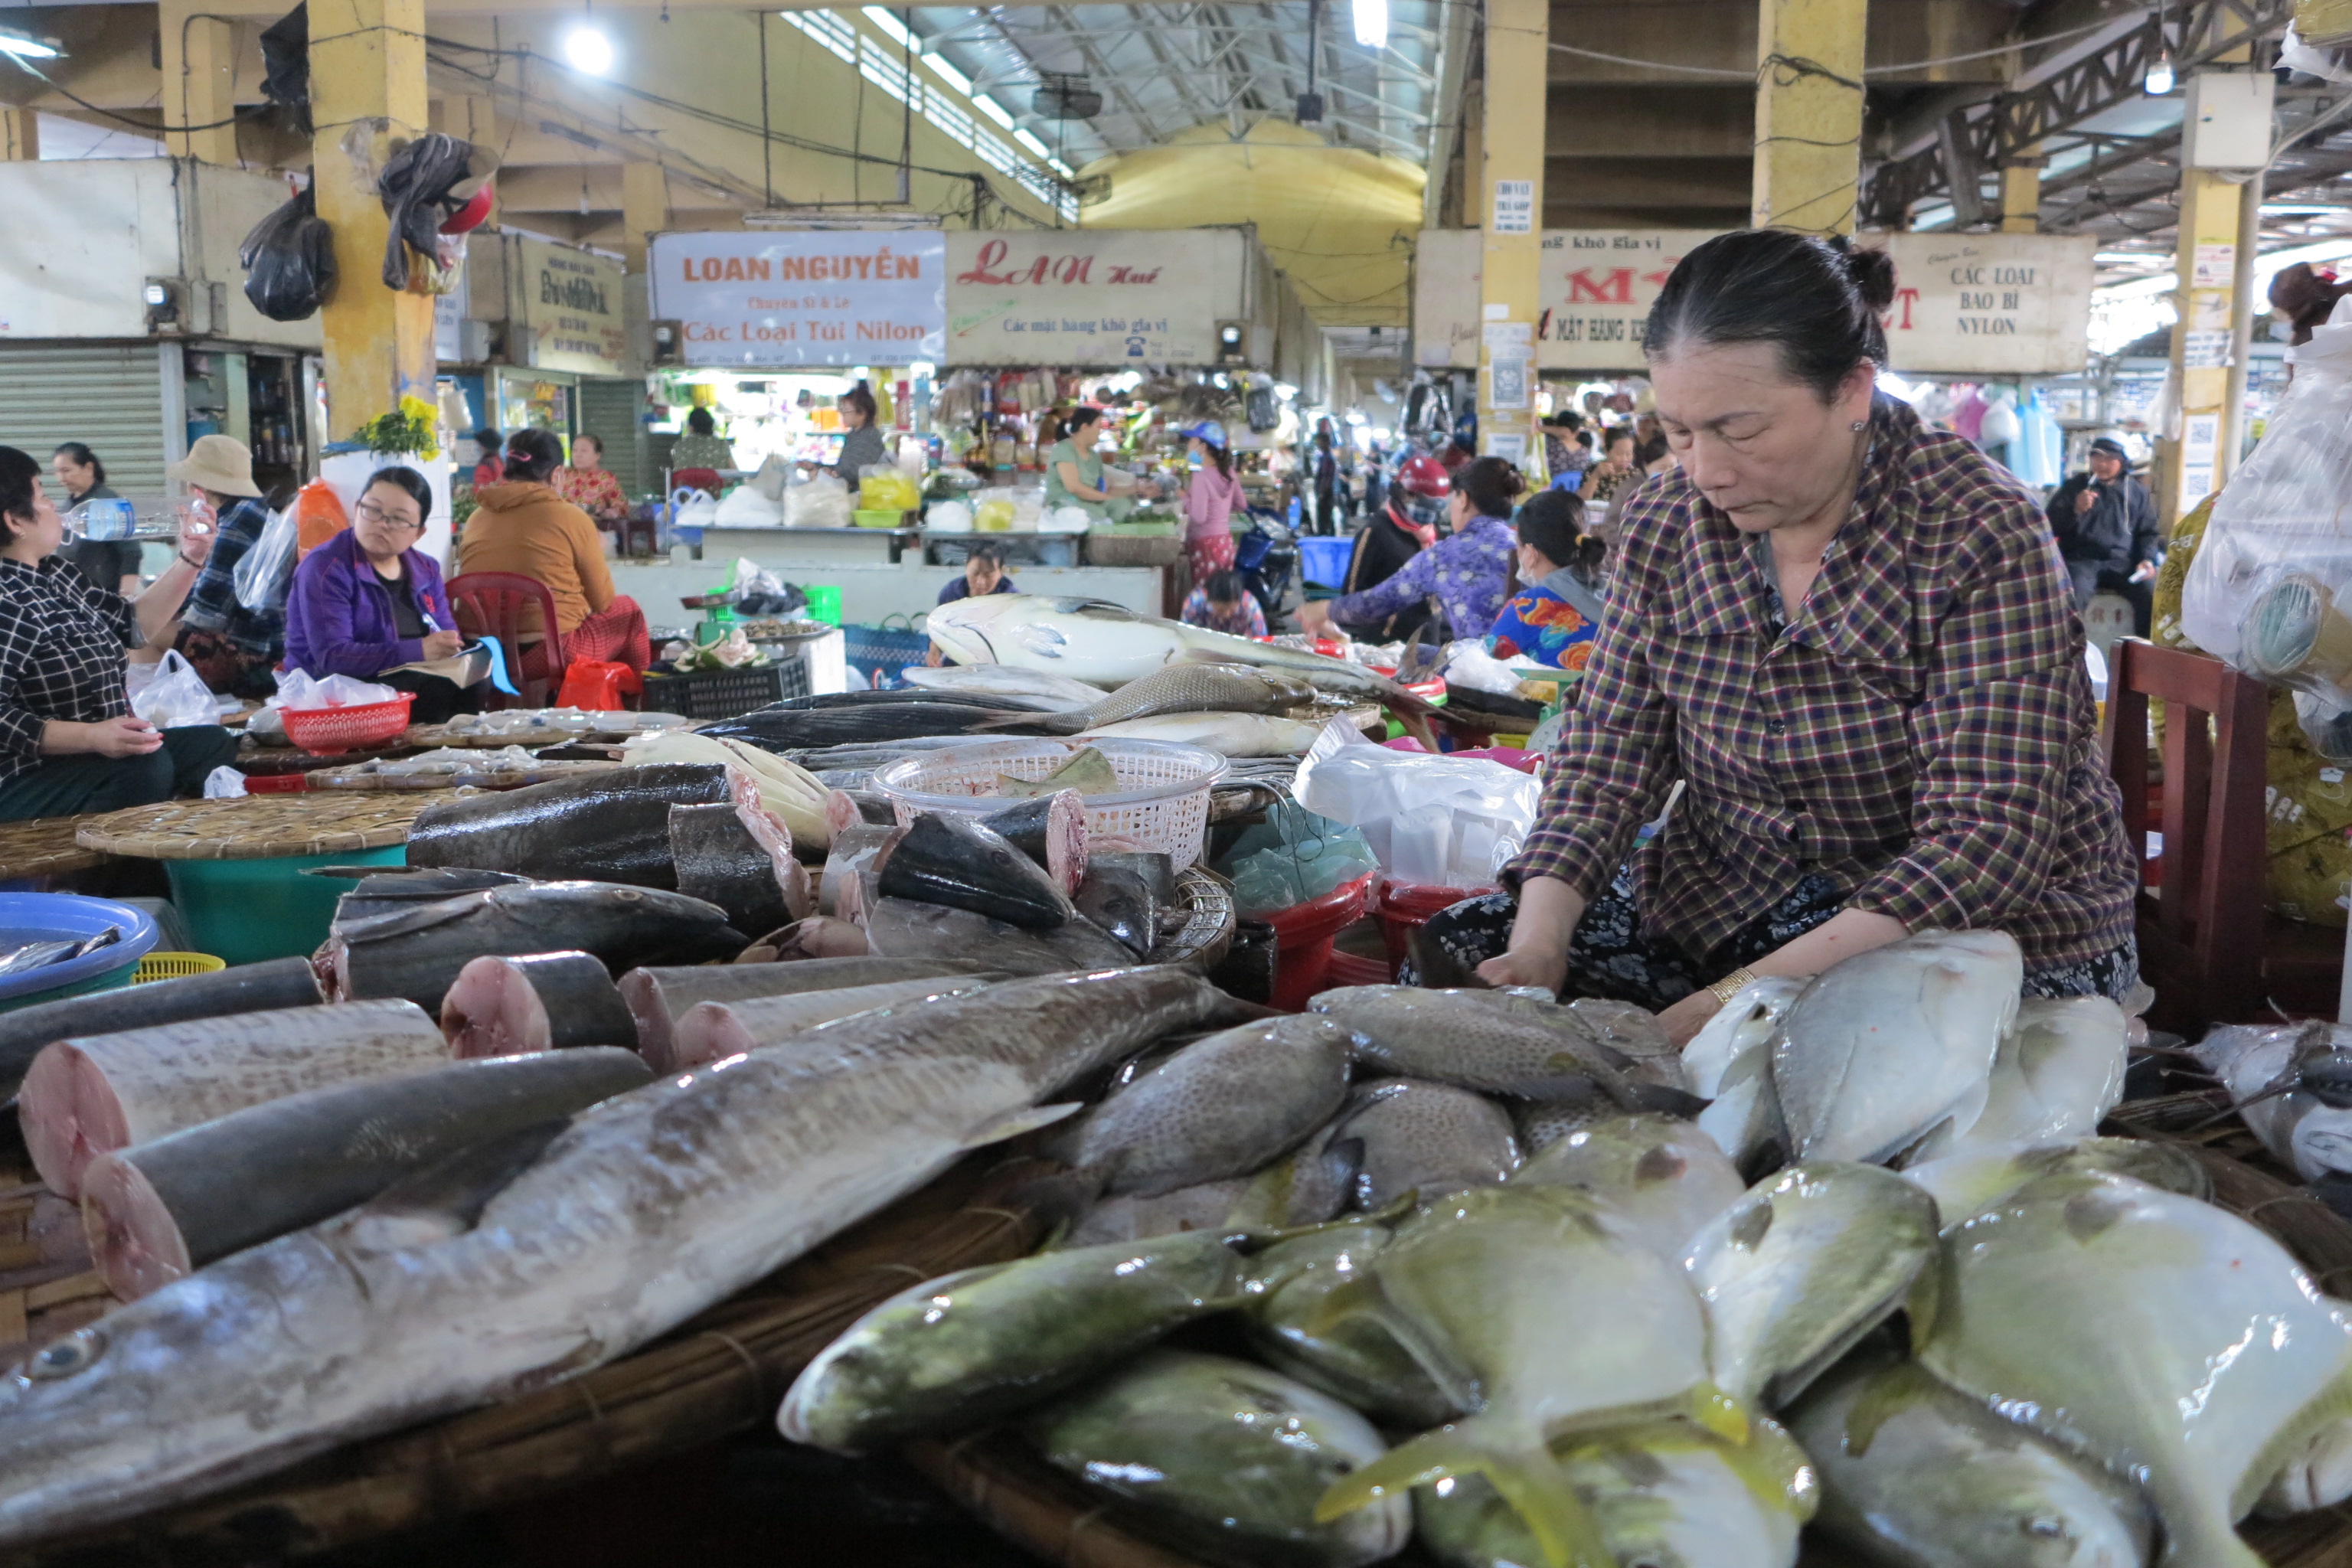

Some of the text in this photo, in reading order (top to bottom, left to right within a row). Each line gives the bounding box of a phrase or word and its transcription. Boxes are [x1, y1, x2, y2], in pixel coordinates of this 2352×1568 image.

[1541, 236, 1564, 250] ng
[1612, 237, 1641, 250] gia
[683, 256, 771, 282] LOAN
[1950, 263, 1986, 285] CÁC
[1960, 289, 2020, 309] BAO BÌ
[682, 320, 926, 346] Các Loại Túi Nilon
[1003, 318, 1027, 332] Các
[1589, 313, 1624, 341] HÀNG
[1958, 317, 2017, 335] NYLON
